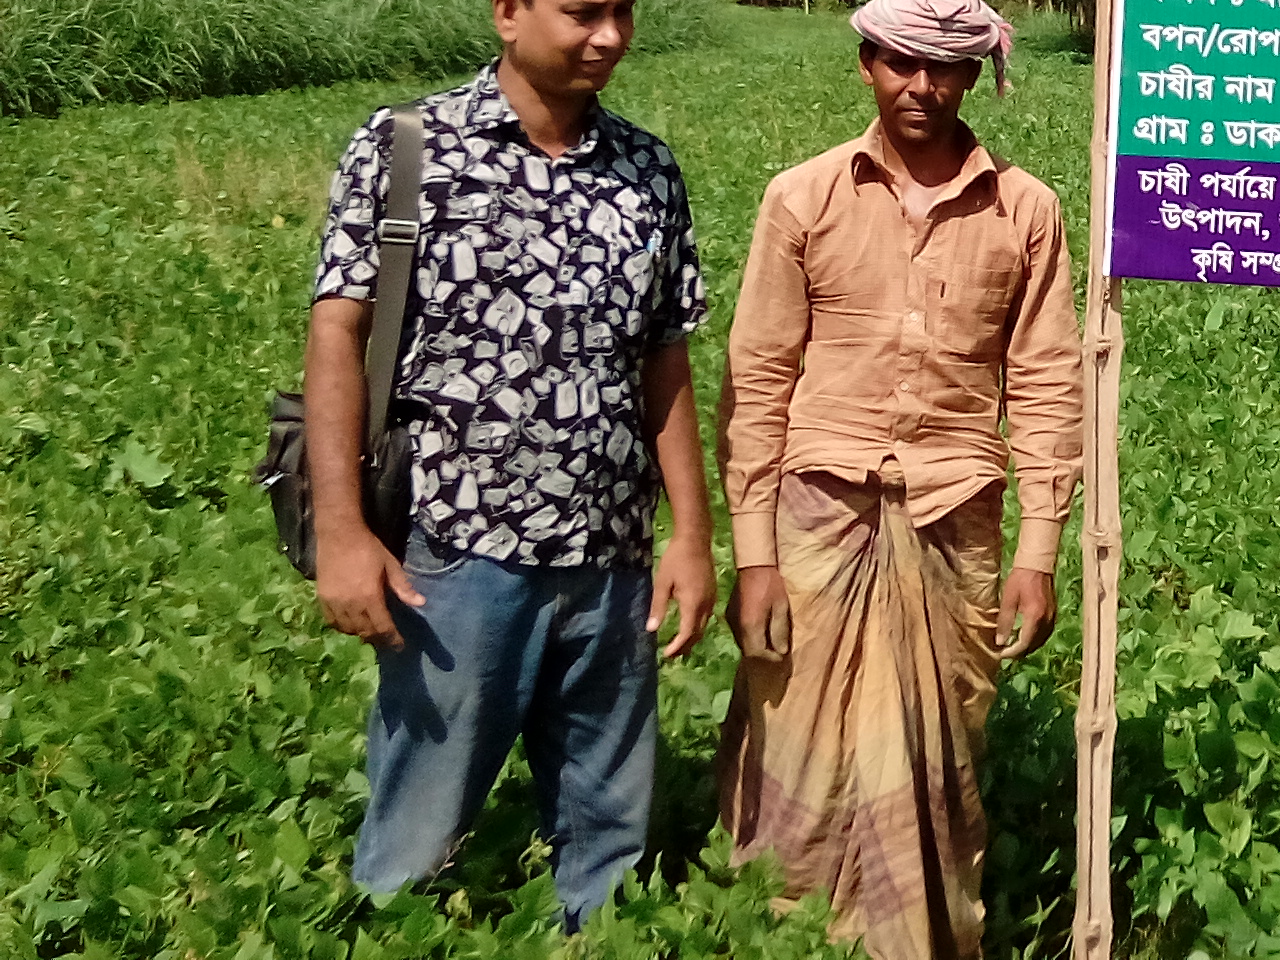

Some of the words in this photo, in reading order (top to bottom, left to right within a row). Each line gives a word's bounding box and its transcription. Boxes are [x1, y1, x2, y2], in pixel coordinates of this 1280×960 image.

[1137, 64, 1216, 101] চাষীর
[1223, 74, 1276, 104] নাম
[1133, 114, 1190, 145] গ্রাম
[1137, 163, 1190, 196] চাষী
[1200, 166, 1277, 201] পর্যায়ে
[1159, 200, 1271, 241] উৎপাদন,
[1191, 241, 1235, 283] কৃষি
